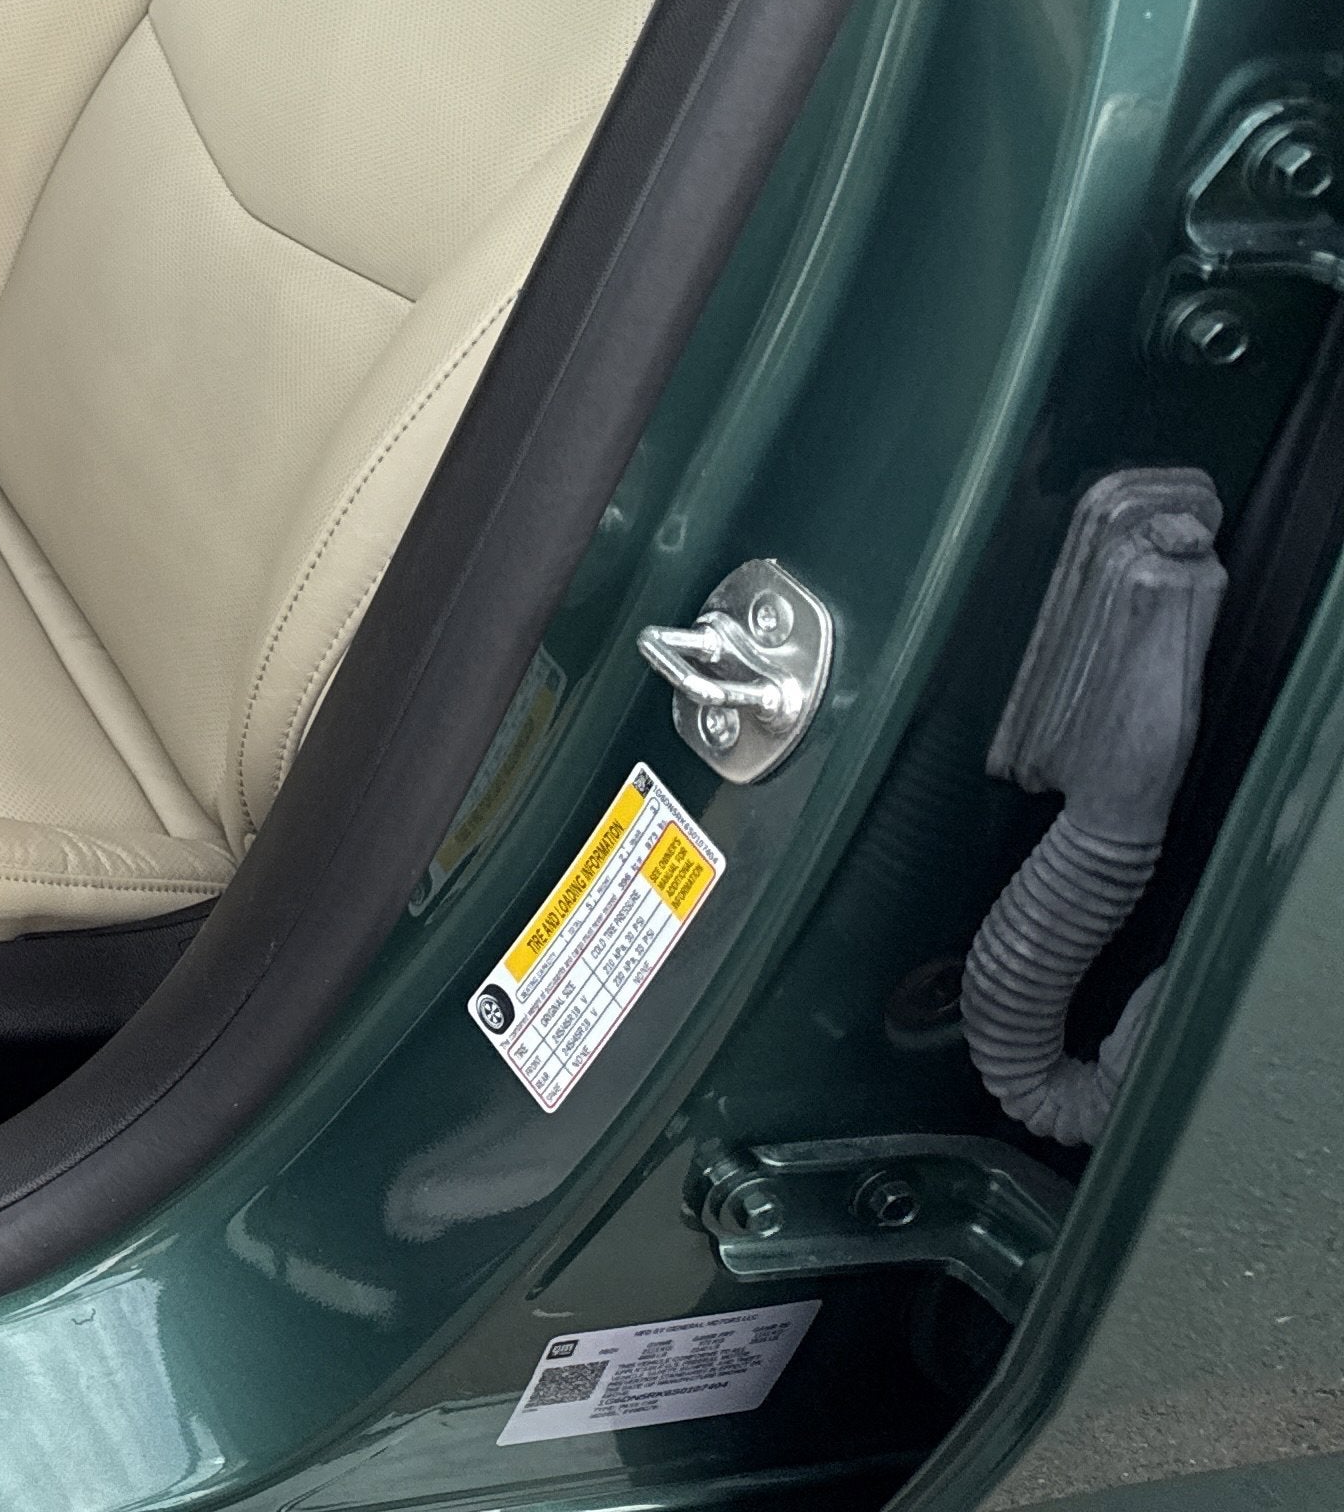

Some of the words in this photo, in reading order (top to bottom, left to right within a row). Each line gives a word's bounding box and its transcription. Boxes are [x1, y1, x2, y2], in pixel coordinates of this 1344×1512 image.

[674, 846, 688, 863] FOR
[526, 928, 548, 954] TIRE
[541, 911, 560, 937] AND
[554, 874, 587, 918] LOADING
[581, 821, 624, 880] INFORMATION
[666, 859, 694, 897] ADDITIONAL
[671, 864, 703, 909] INFORMATION
[590, 937, 607, 959] COLD
[602, 922, 617, 938] TIRE
[613, 889, 640, 926] PRESSURE
[631, 915, 645, 932] PSI
[641, 928, 655, 945] PSI
[632, 960, 651, 984] NONE
[540, 998, 565, 1027] ORIGINAL
[571, 1044, 590, 1067] NONE
